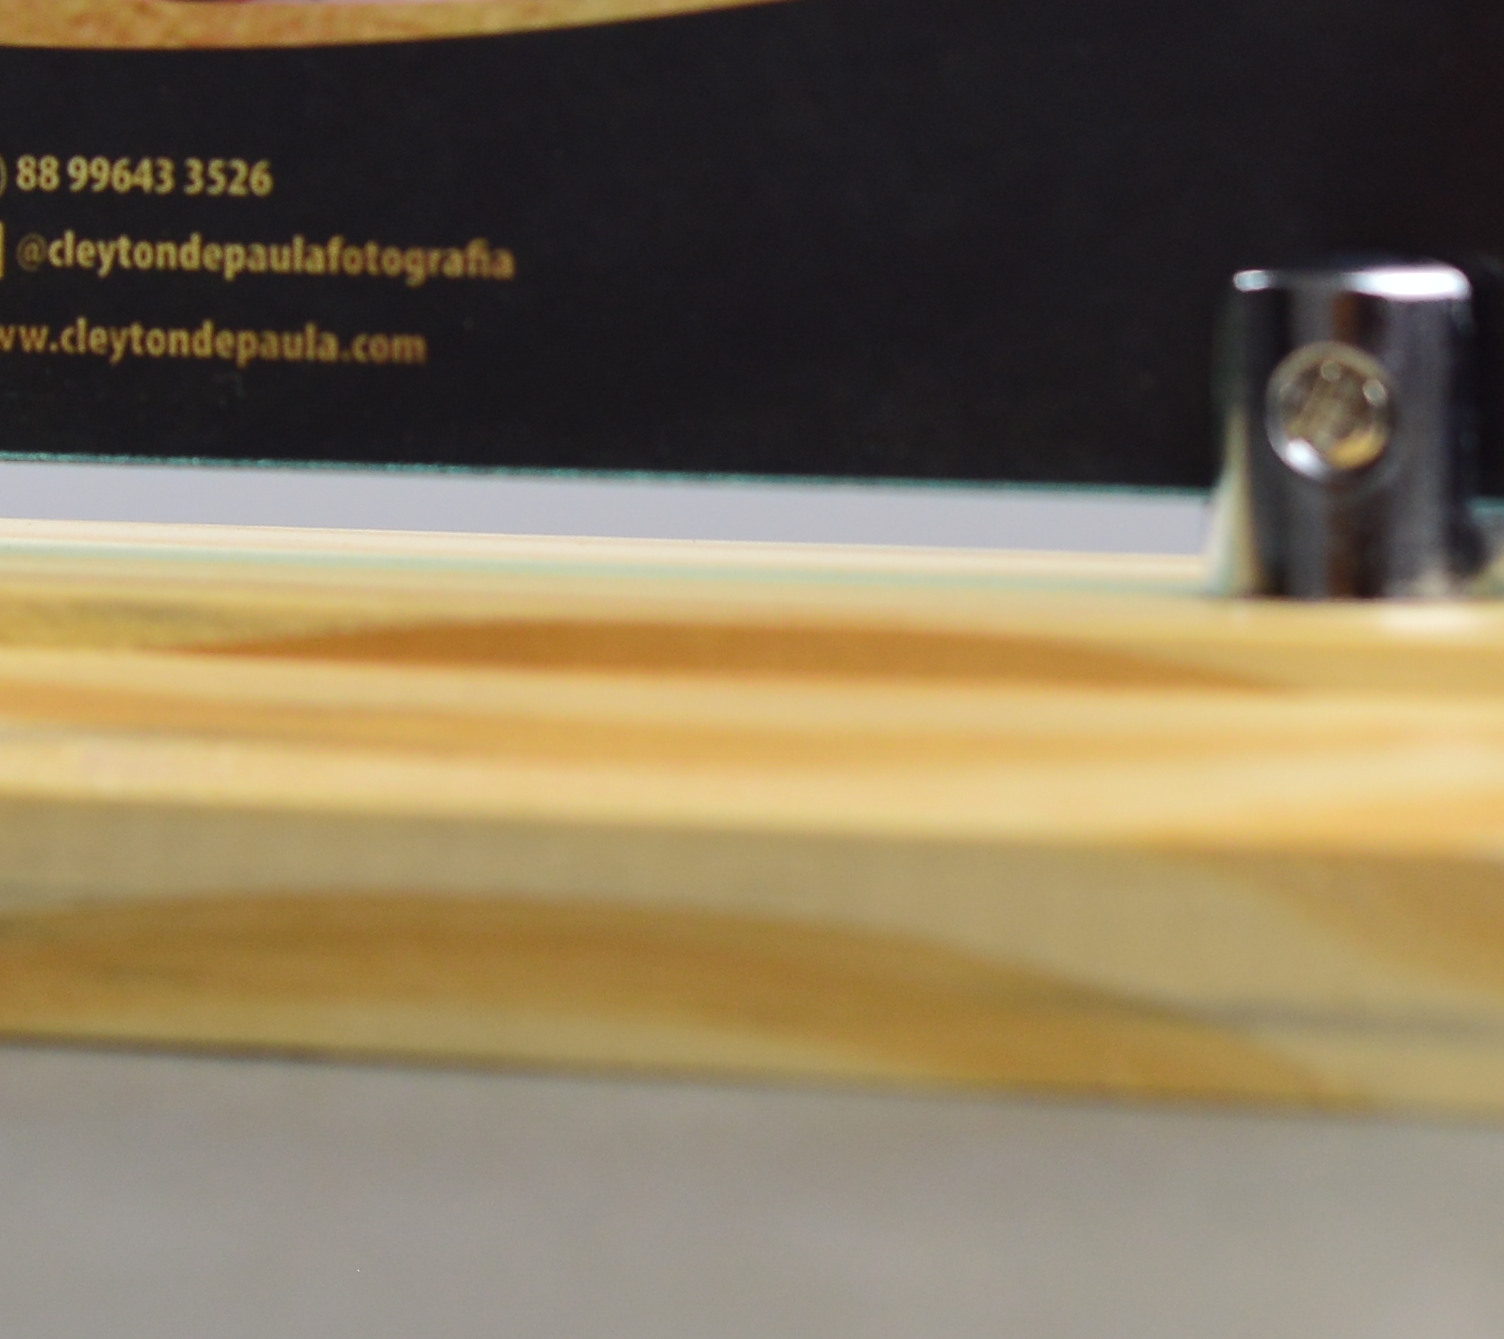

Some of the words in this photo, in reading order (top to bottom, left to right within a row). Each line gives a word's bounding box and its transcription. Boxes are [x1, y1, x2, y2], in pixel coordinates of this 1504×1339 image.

[15, 154, 60, 191] 88
[66, 156, 175, 195] 99643
[183, 157, 273, 197] 3526
[16, 230, 516, 288] @cleytondepaulafotografia
